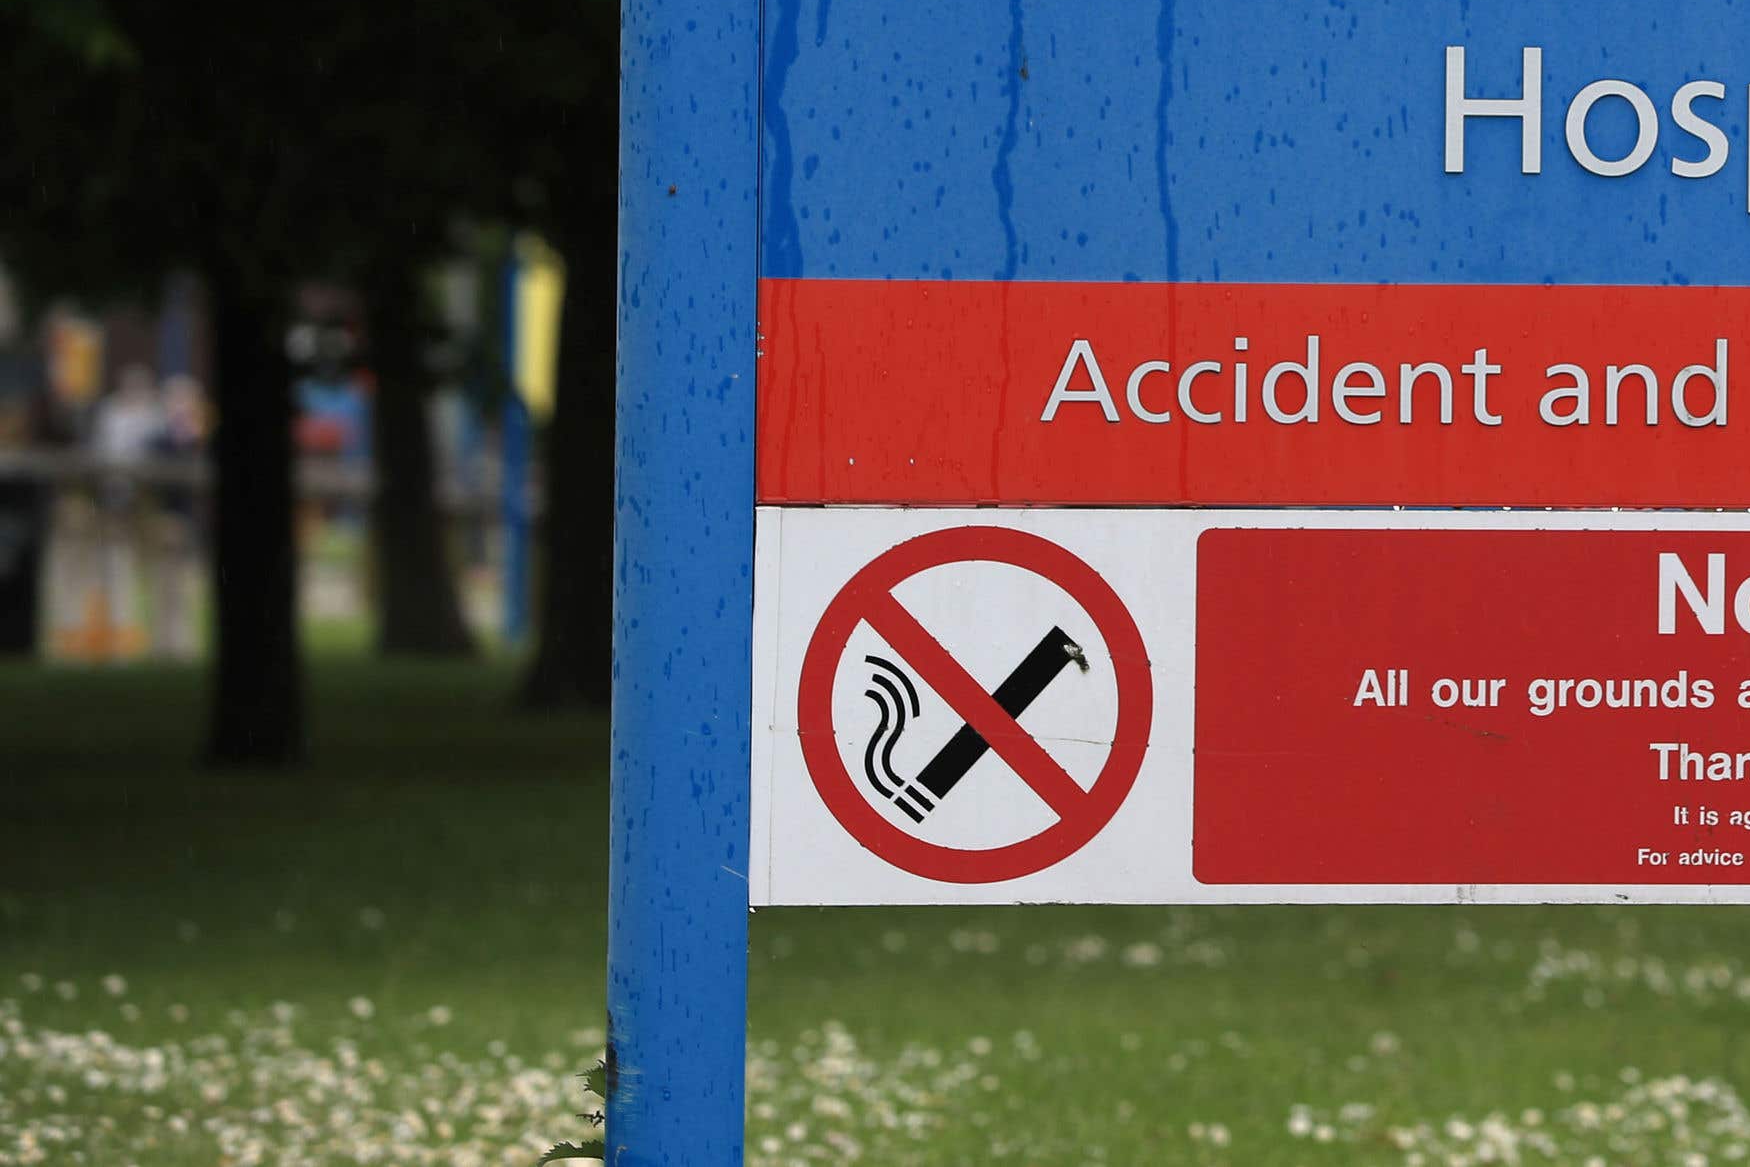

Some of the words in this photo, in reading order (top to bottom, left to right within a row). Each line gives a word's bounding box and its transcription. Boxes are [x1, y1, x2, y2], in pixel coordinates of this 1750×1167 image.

[1040, 335, 1502, 426] Accident
[1539, 338, 1728, 427] and
[1353, 669, 1409, 707] All
[1431, 678, 1507, 708] our
[1527, 670, 1715, 717] grounds
[1673, 805, 1690, 825] It
[1699, 805, 1719, 826] is
[1637, 848, 1670, 866] For
[1678, 848, 1744, 866] advice
